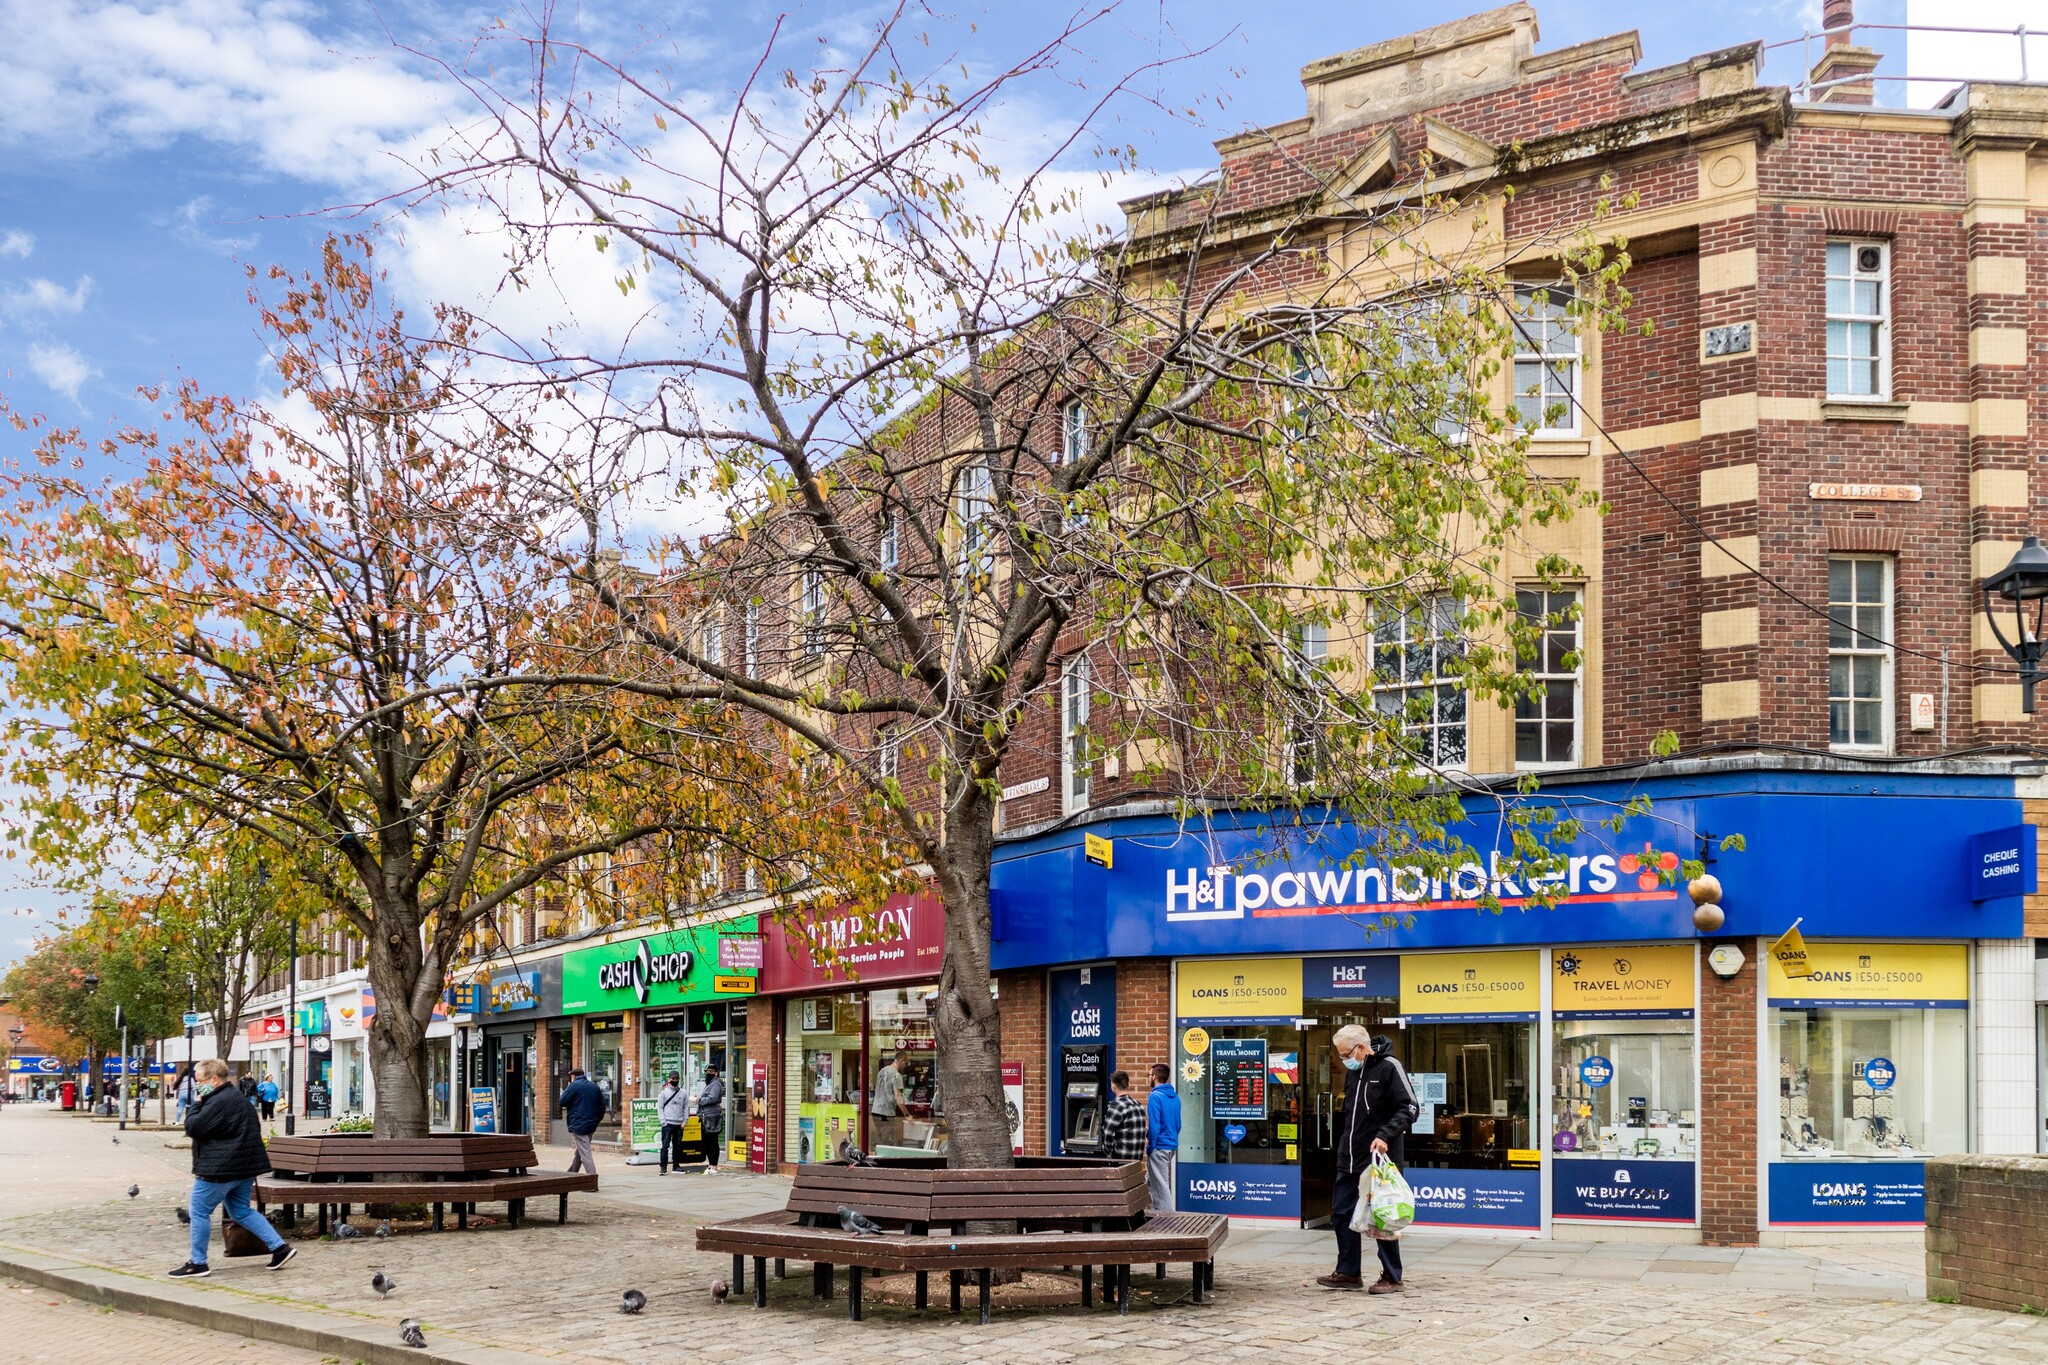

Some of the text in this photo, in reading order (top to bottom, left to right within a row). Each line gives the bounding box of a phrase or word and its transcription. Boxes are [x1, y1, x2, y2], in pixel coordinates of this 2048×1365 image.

[1818, 485, 1888, 498] COLLEGE
[1004, 781, 1040, 799] FFINGHAM
[1984, 848, 2018, 864] CHEQUE
[1982, 863, 2020, 878] CASHING
[1167, 850, 1618, 918] H&T pawnbrokers
[851, 948, 905, 964] Service People
[917, 946, 939, 956] Est 1903
[1776, 950, 1806, 961] LOANS
[599, 951, 689, 990] CASH SHOP
[1332, 966, 1366, 981] H&T
[1807, 972, 1923, 982] LOANS £50-£5000
[1417, 982, 1525, 994] LOANS £50-£5000
[1574, 980, 1672, 991] TRAVEL MONEY
[1192, 987, 1288, 998] LOANS £50-£5000
[1071, 1008, 1100, 1024] CASH
[1071, 1025, 1100, 1038] LOANS
[1065, 1053, 1100, 1064] Free Cash
[1067, 1064, 1097, 1072] withdrawals
[1584, 1067, 1610, 1076] BEAT
[1868, 1070, 1893, 1079] BEAT
[1190, 1180, 1237, 1193] LOANS
[1414, 1186, 1466, 1200] LOANS
[1576, 1187, 1597, 1198] WE
[1600, 1187, 1628, 1199] BUY
[1812, 1183, 1867, 1197] LOANS
